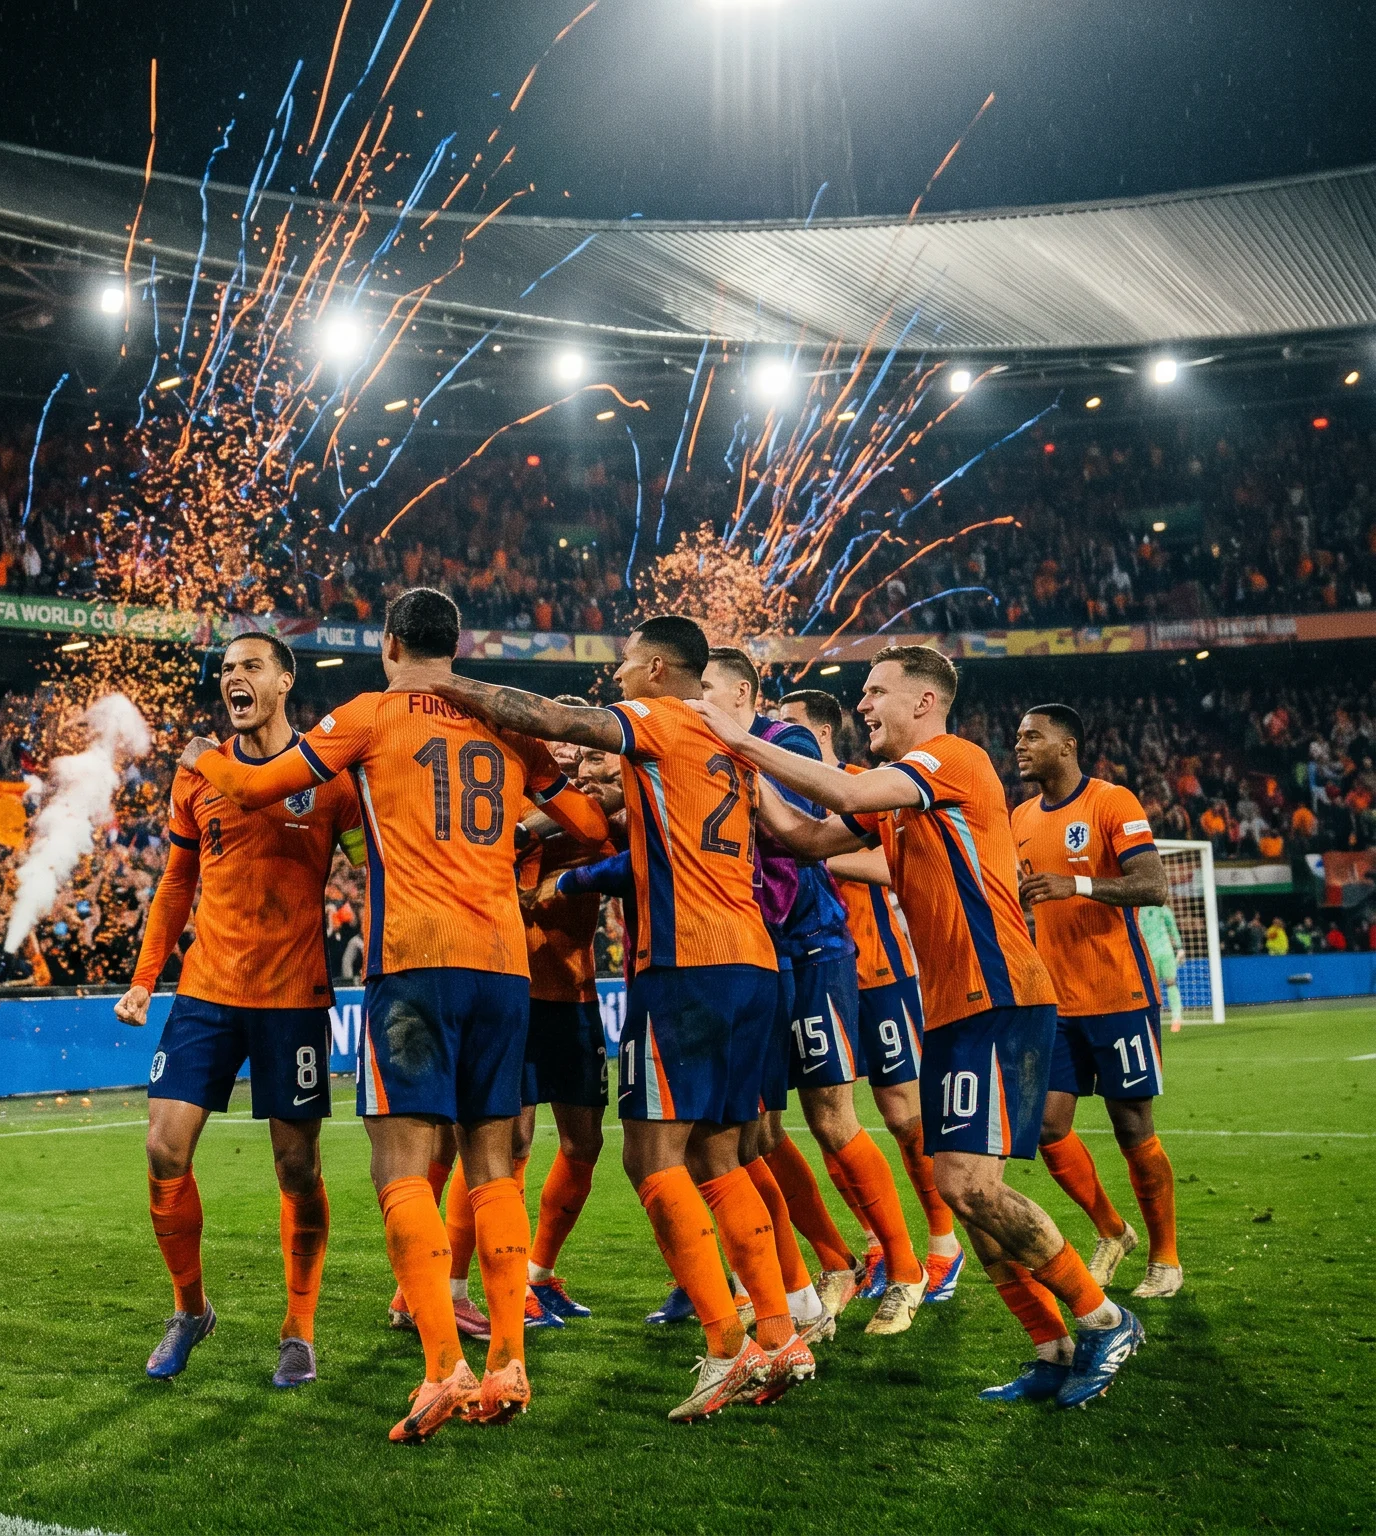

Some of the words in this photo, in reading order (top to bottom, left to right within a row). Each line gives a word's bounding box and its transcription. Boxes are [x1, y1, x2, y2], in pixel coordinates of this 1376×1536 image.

[20, 602, 87, 627] WORLD
[412, 736, 505, 846] 18
[791, 1015, 830, 1059] 15
[878, 1019, 903, 1059] 9
[1113, 1034, 1147, 1074] 11
[296, 1046, 318, 1089] 8
[941, 1071, 978, 1117] 10
